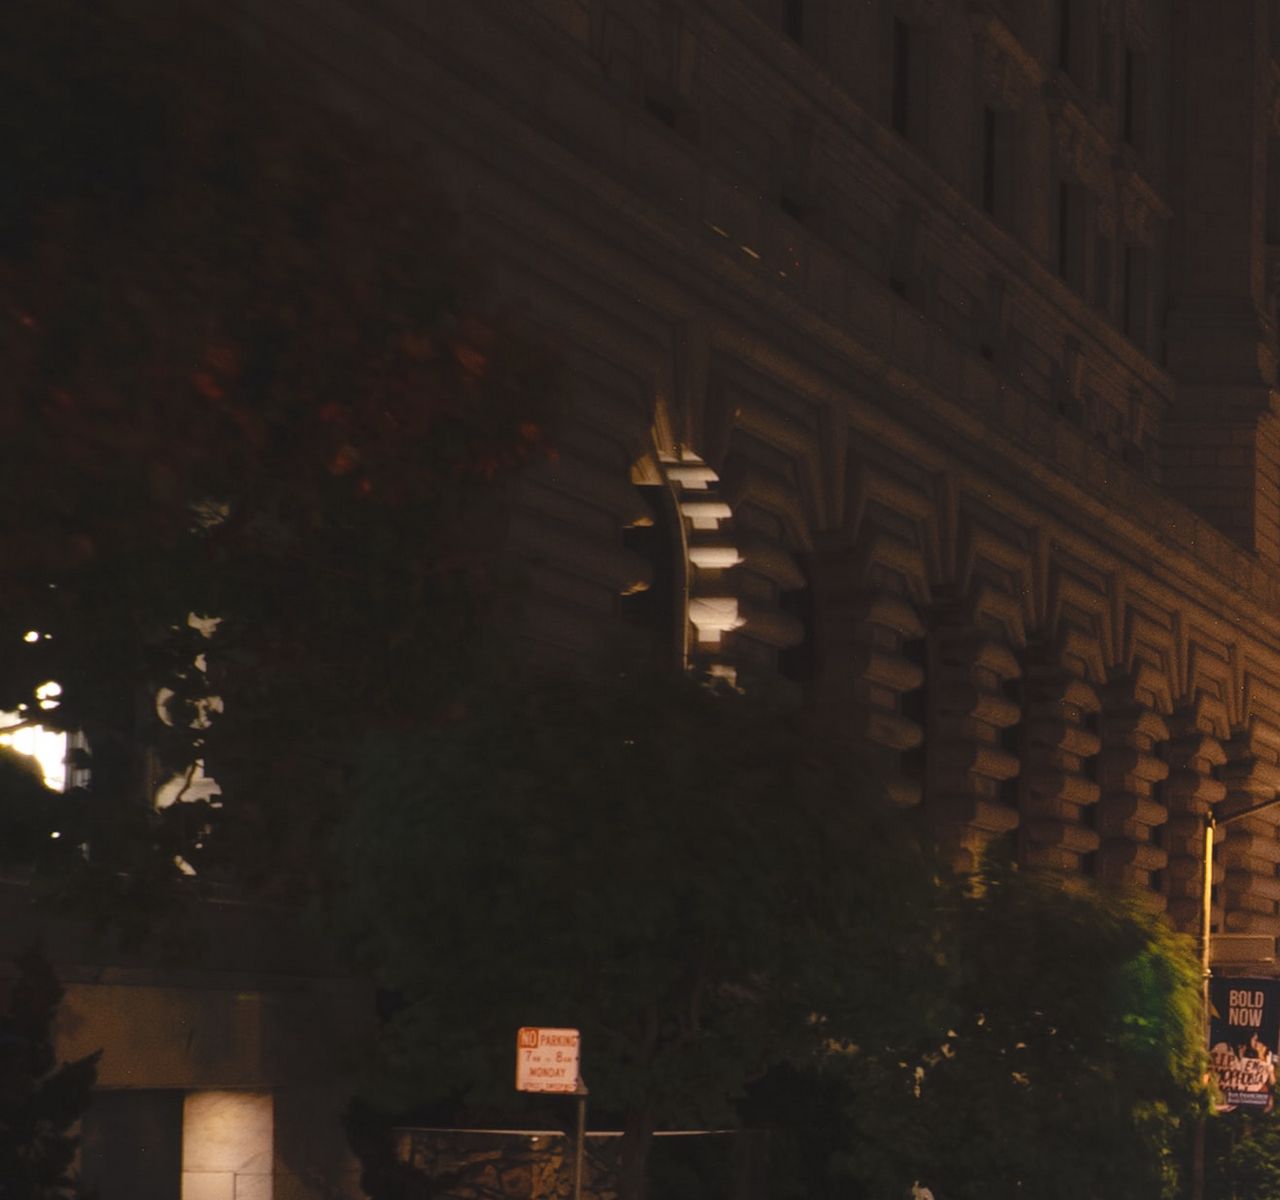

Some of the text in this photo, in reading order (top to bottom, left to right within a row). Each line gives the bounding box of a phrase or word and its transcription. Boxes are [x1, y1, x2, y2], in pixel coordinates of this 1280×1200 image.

[1229, 989, 1264, 1008] BOLD
[1228, 1007, 1263, 1027] NOW
[521, 1029, 579, 1048] NO PARKING
[529, 1067, 565, 1077] MONDAY
